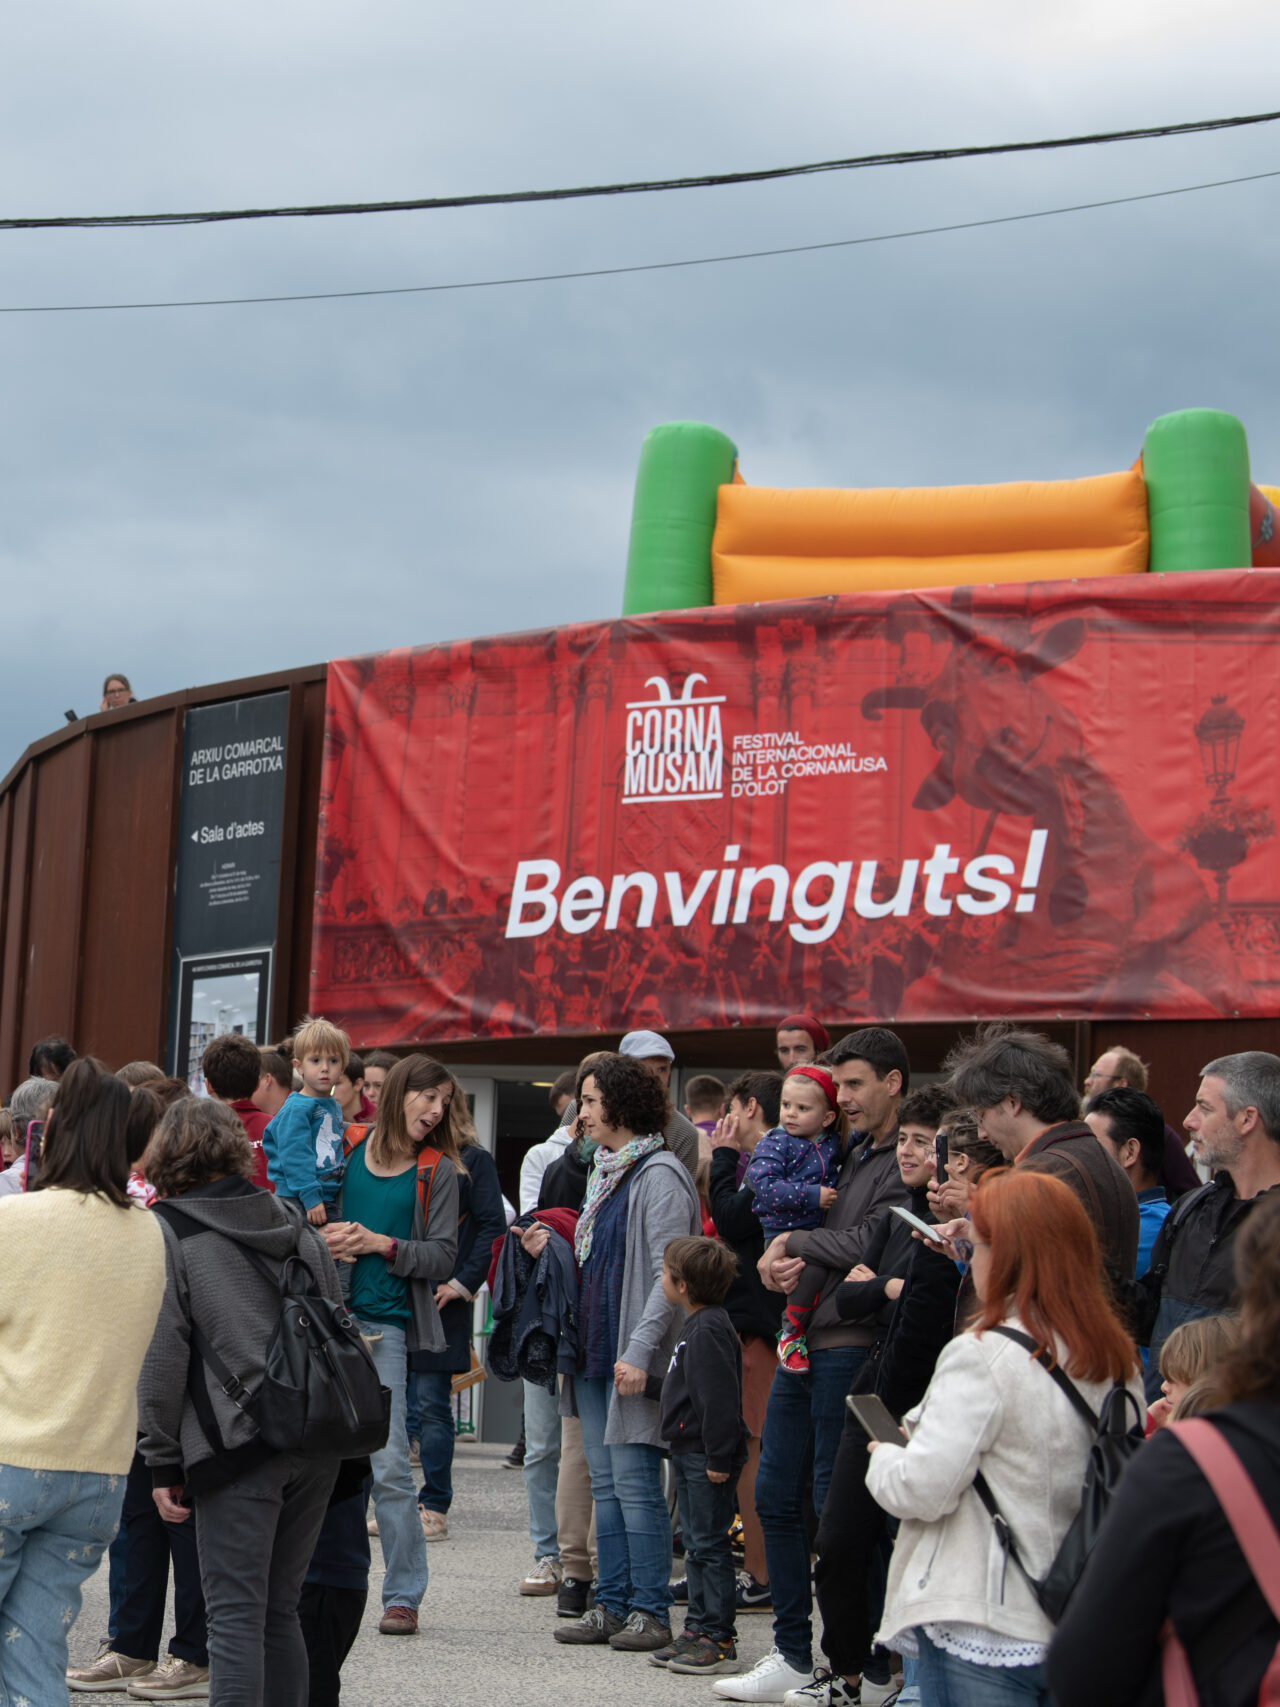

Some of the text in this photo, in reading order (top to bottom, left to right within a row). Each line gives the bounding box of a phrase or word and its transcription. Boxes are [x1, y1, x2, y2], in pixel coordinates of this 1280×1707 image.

[626, 705, 723, 756] CORNA
[733, 732, 805, 750] FESTIVAL
[191, 736, 284, 766] ARXIU COMARCAL
[732, 743, 856, 766] INTERNACIONAL
[189, 755, 283, 786] DE LA GARROTXA
[624, 751, 723, 796] MUSAM
[731, 757, 888, 782] DE LA CORNAMUSA
[731, 780, 788, 798] D'OLOT
[200, 820, 265, 844] Sala d'actes
[505, 829, 1048, 945] Benvinguts!
